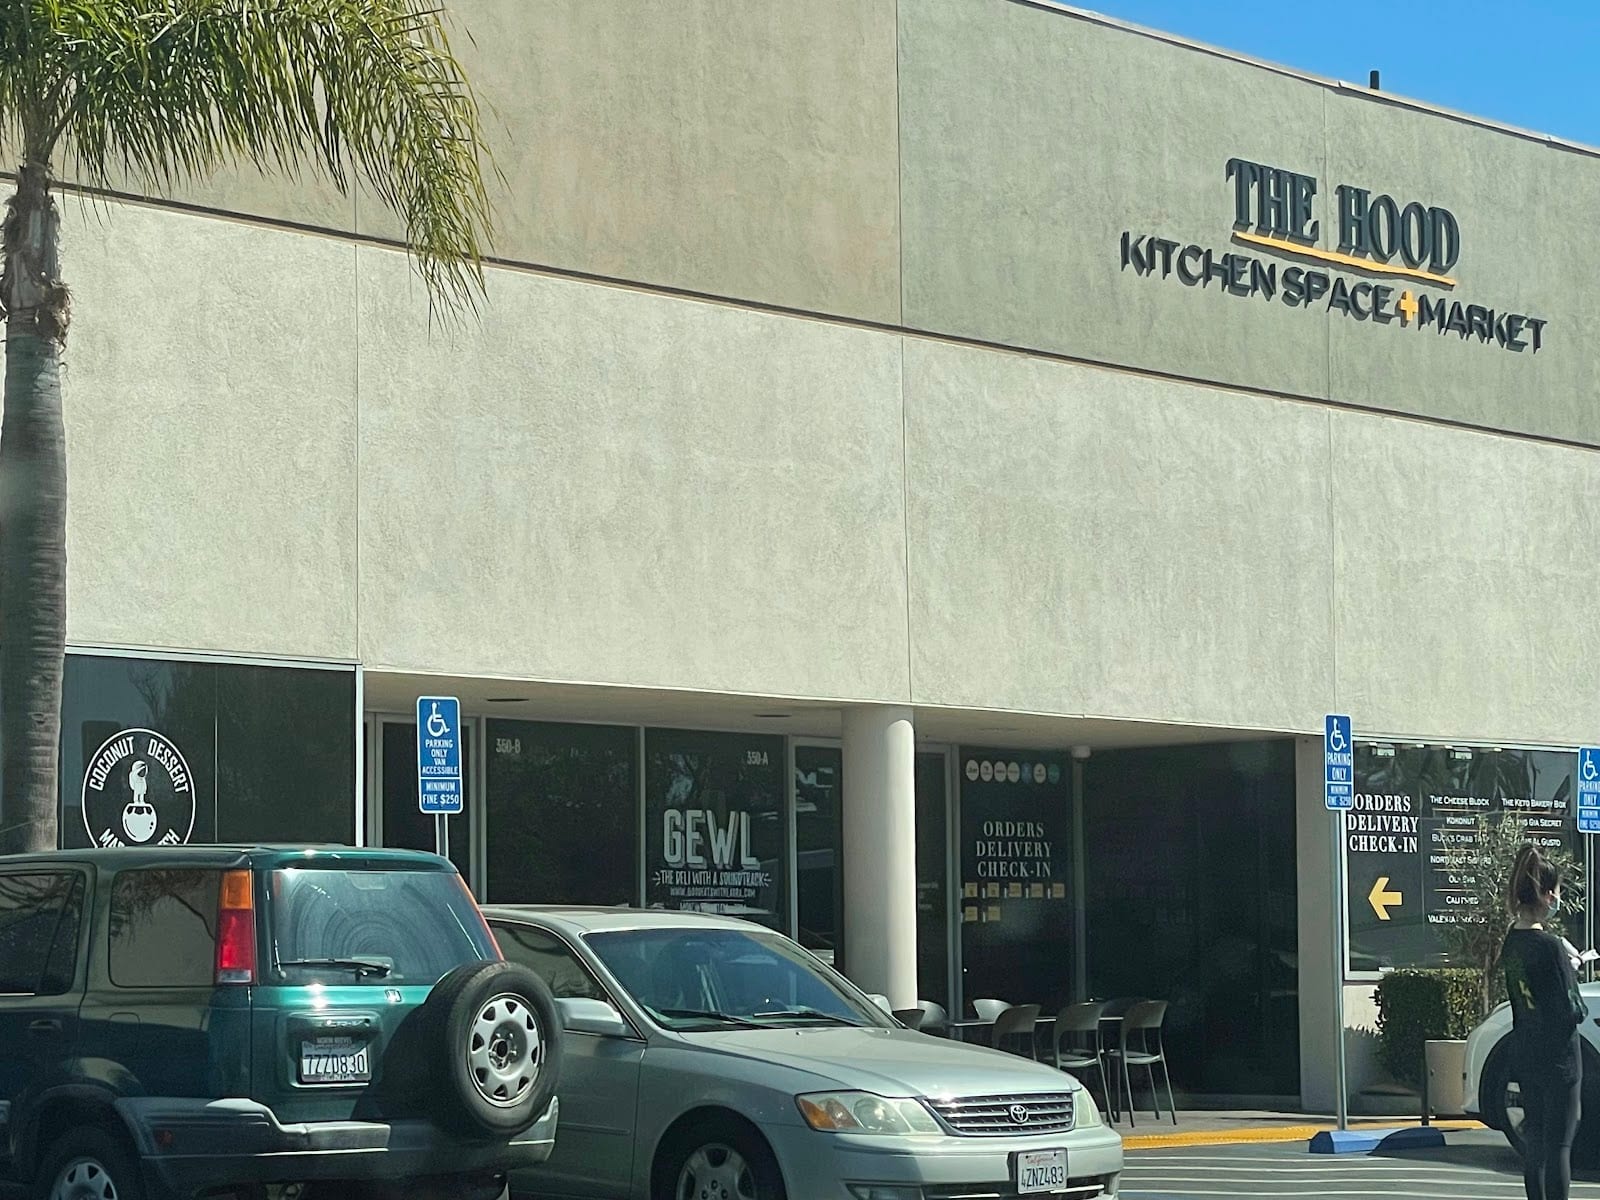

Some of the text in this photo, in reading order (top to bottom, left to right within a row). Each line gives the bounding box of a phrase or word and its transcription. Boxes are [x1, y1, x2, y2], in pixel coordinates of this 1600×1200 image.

[1226, 157, 1460, 275] THE HOOD
[1120, 231, 1276, 301] KITCHEN
[1282, 267, 1395, 325] SPACE
[1418, 294, 1548, 354] MARKET
[425, 739, 453, 748] PARKING
[496, 738, 521, 754] 350-B
[431, 749, 448, 757] ONLY
[747, 750, 769, 765] 350-A
[1327, 752, 1351, 766] PARKING
[89, 736, 189, 793] COCONUT DESSERT
[422, 766, 458, 775] ACCESSIBLE
[1332, 767, 1347, 780] ONLY
[426, 781, 455, 792] MINIMUM
[423, 794, 459, 804] FINE $250
[1354, 793, 1411, 812] ORDERS
[1430, 795, 1443, 804] THE
[1502, 798, 1514, 806] THE
[983, 821, 1044, 837] ORDERS
[1347, 814, 1419, 832] DELIVERY
[664, 809, 760, 870] GEWL
[1349, 835, 1418, 853] CHECK-IN
[976, 841, 1052, 857] DELIVERY
[977, 861, 1051, 877] CHECK-IN
[660, 870, 764, 886] THE DELI WITH A SOUNDTRACK
[304, 1054, 365, 1074] 7ZZD830
[1021, 1166, 1064, 1188] 4ZNZ483
